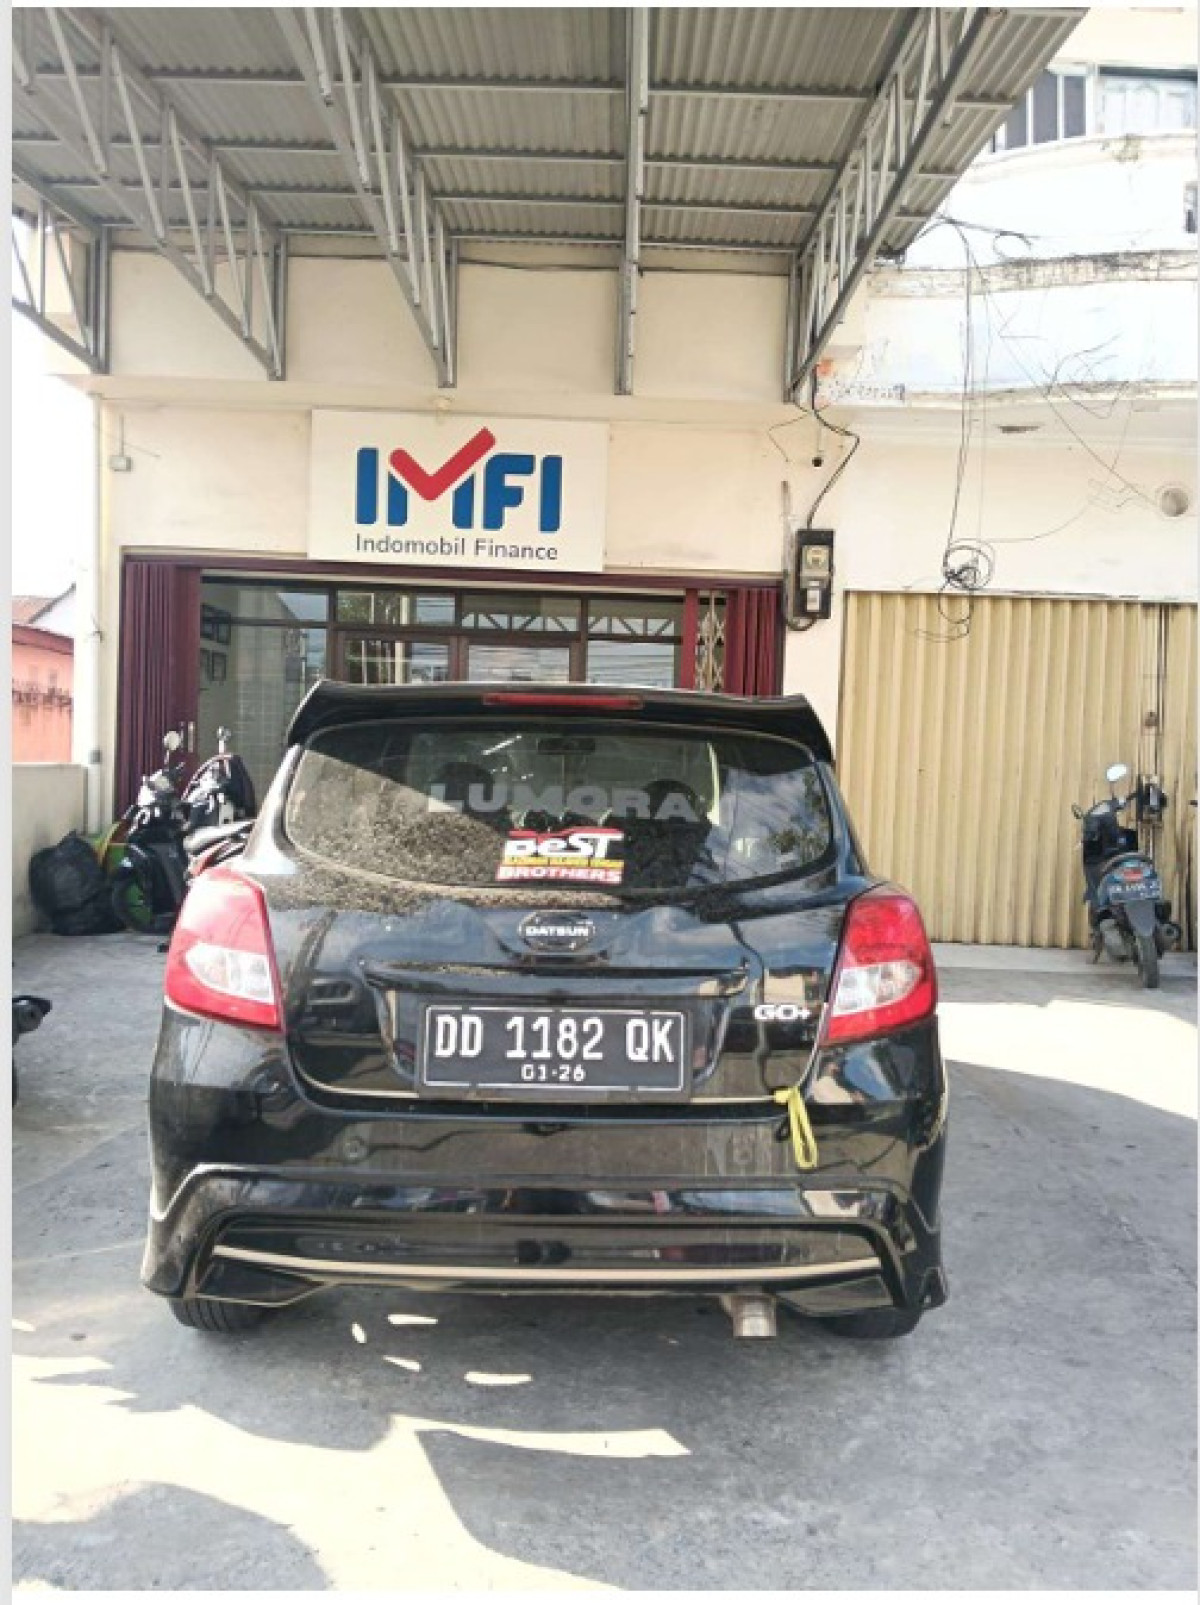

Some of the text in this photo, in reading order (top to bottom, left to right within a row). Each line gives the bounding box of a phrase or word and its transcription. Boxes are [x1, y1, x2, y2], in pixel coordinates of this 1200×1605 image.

[355, 426, 562, 533] IMFI
[356, 533, 558, 561] Indomobil Finance
[428, 782, 701, 823] LUMORA
[497, 867, 623, 884] BROTHERS
[524, 925, 590, 938] DATSUN
[434, 1013, 675, 1063] DD 1182 QK
[520, 1063, 587, 1083] 01-26
